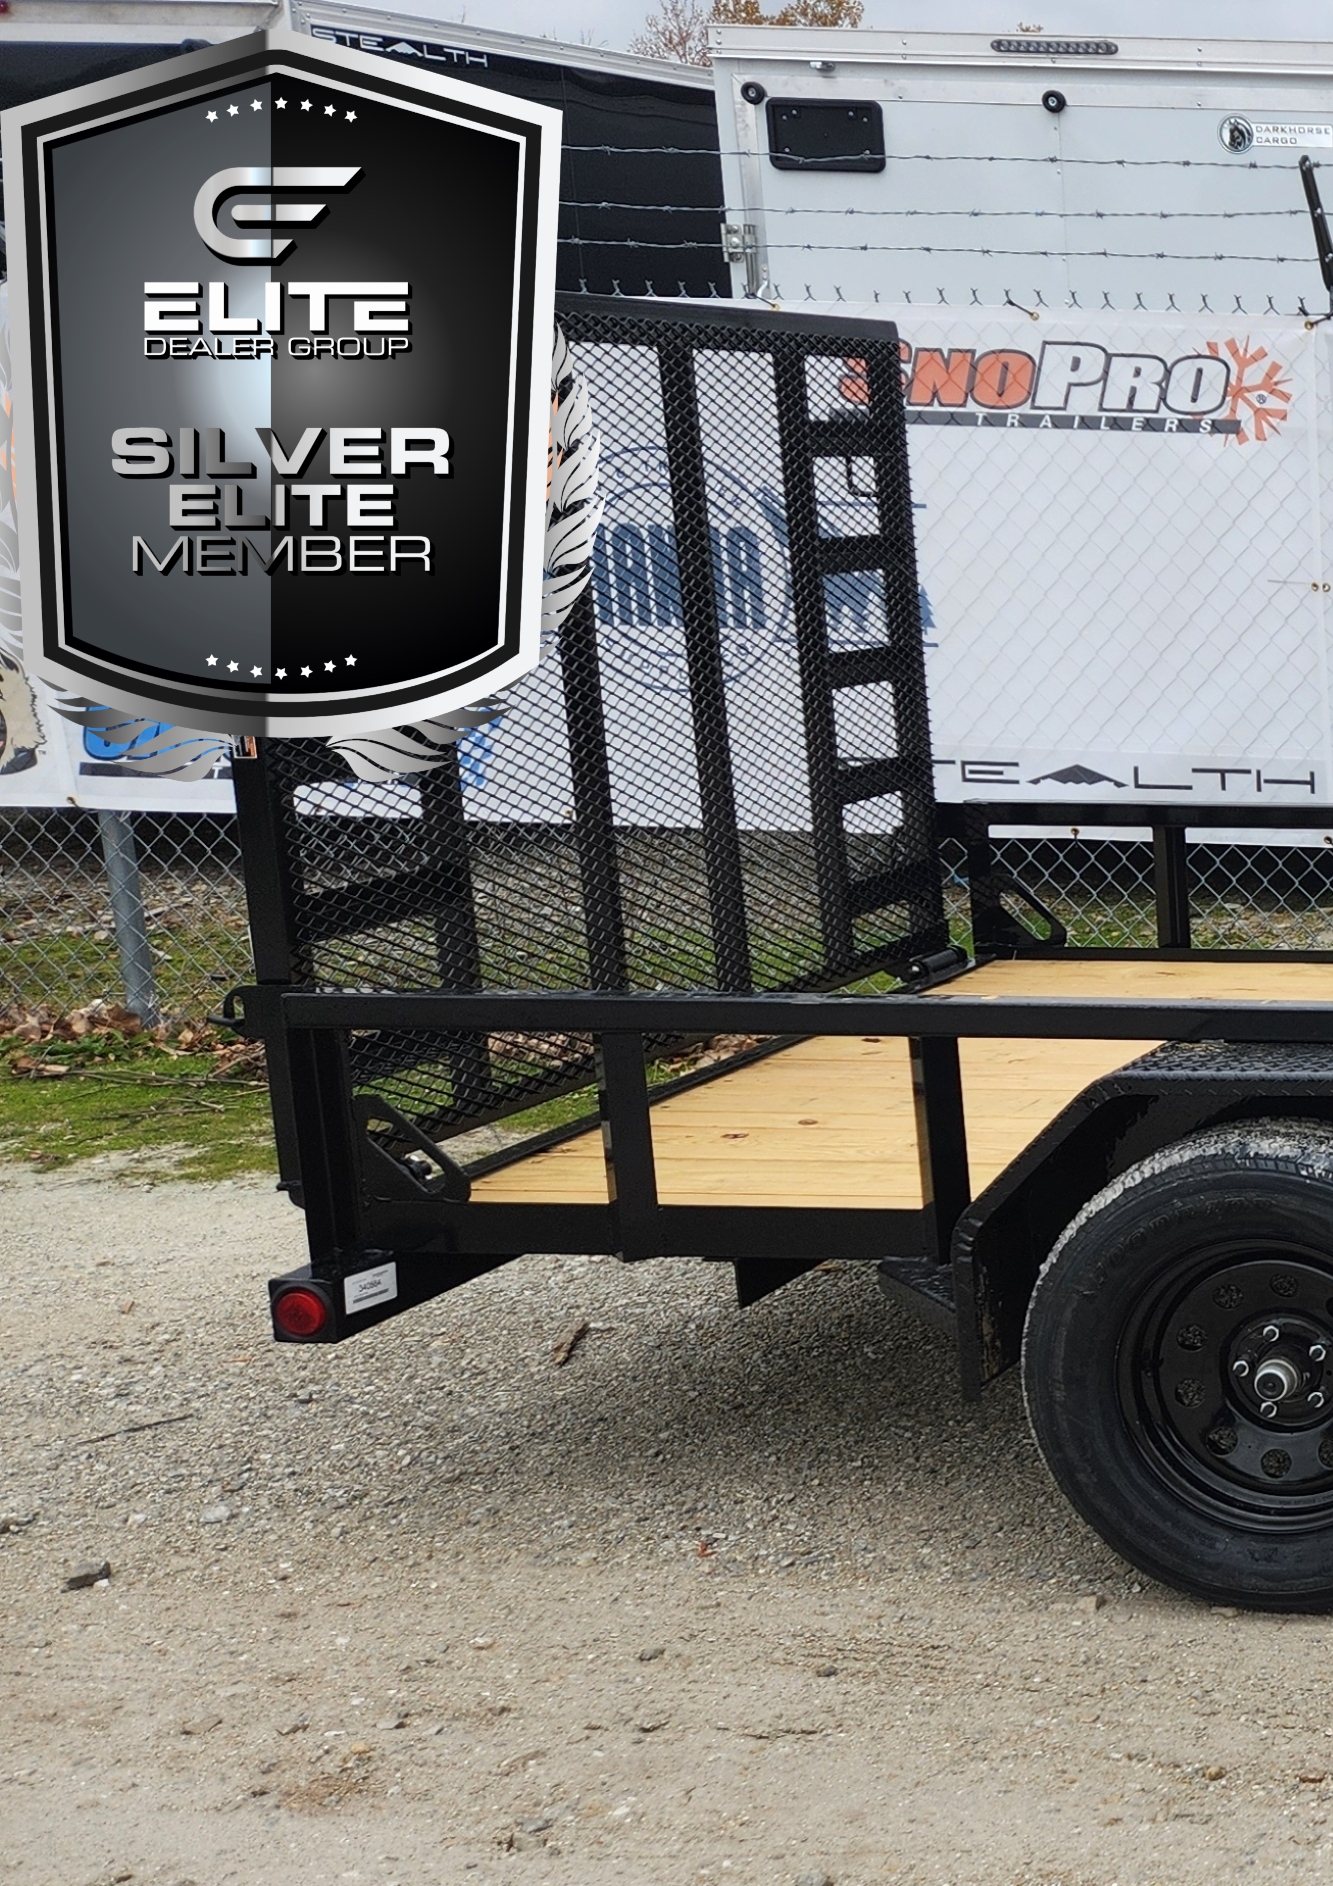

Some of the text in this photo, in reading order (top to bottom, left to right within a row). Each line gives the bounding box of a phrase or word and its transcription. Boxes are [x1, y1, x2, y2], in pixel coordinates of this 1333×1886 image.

[312, 27, 488, 67] STEALTH
[1255, 125, 1330, 135] DARKHORSE
[1256, 136, 1298, 145] CARGO
[975, 412, 1212, 433] TRAILERS
